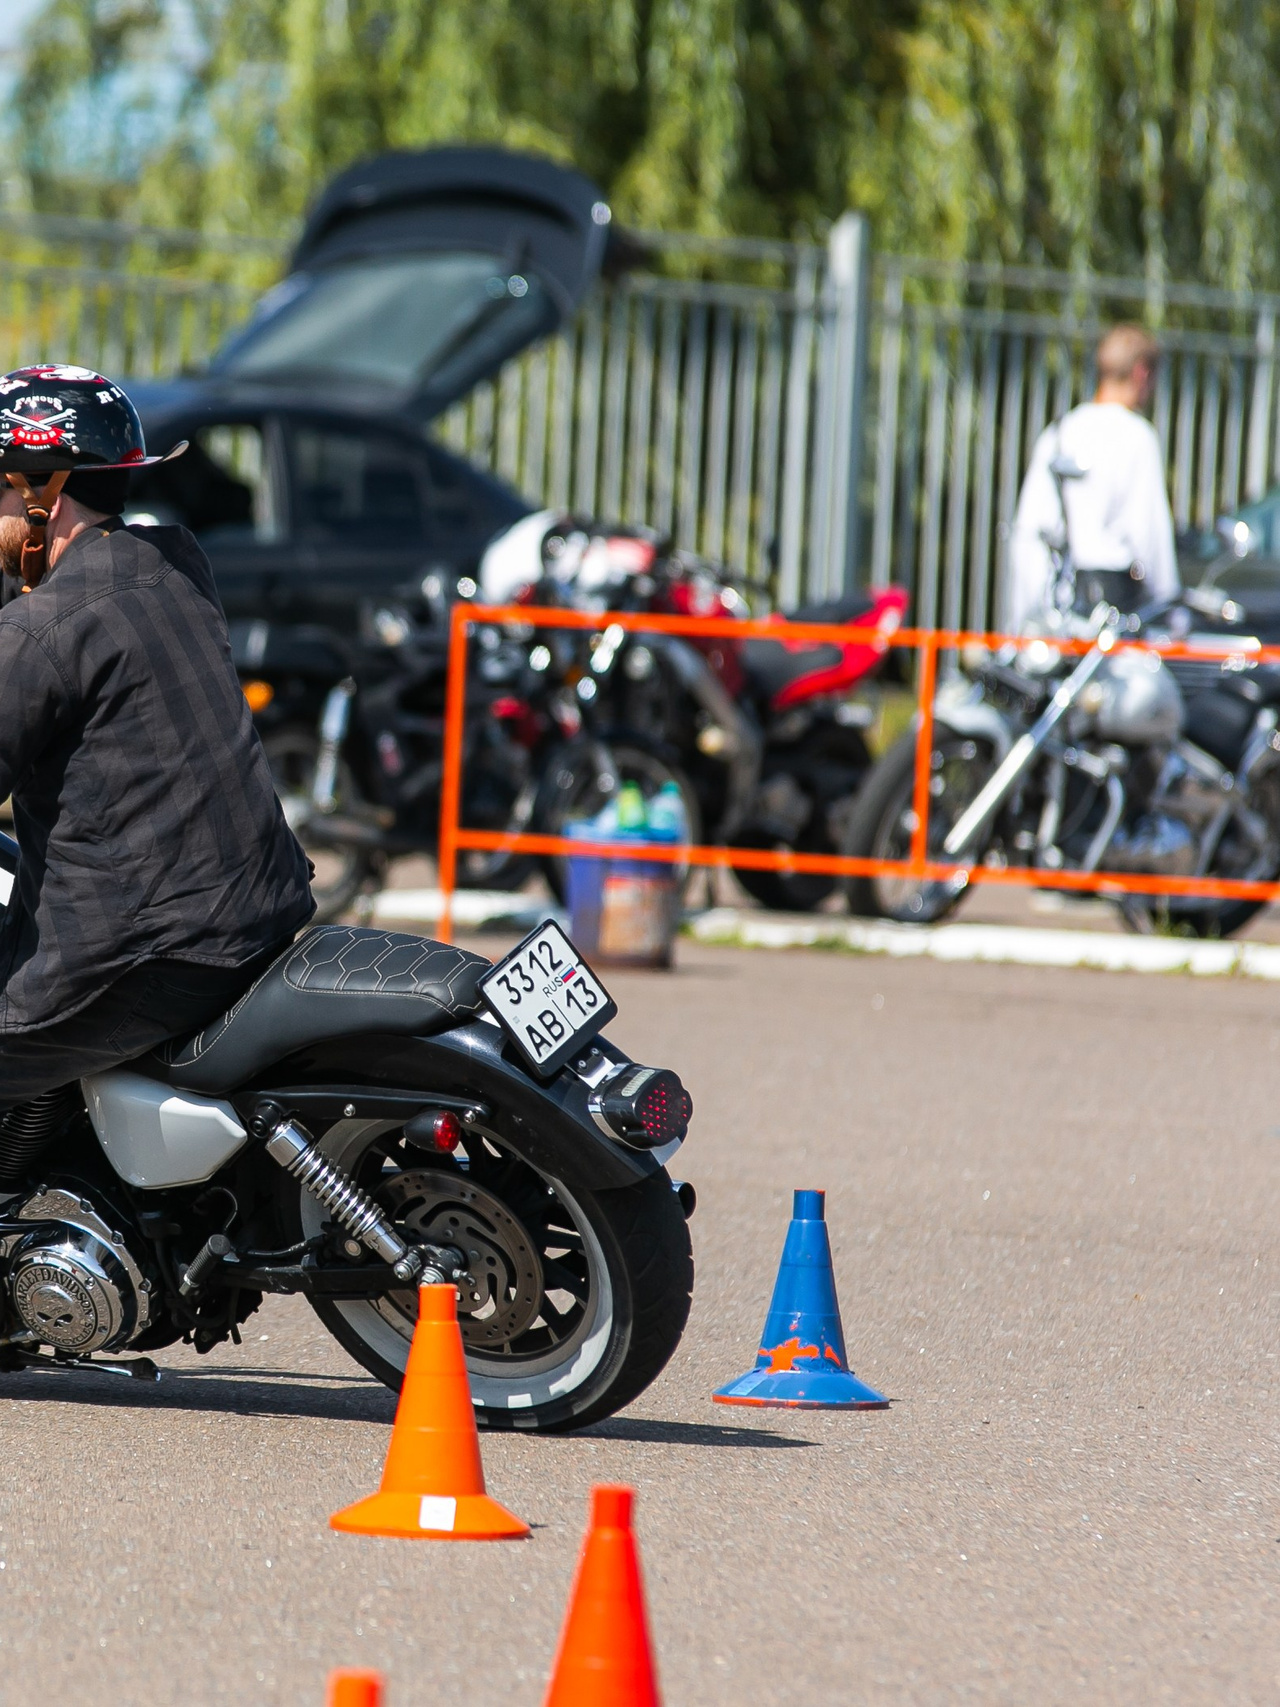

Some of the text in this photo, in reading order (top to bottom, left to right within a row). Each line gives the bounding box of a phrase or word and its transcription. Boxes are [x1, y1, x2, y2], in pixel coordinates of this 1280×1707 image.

[13, 395, 63, 413] FAMOUS
[17, 430, 57, 441] RIDER
[496, 940, 563, 1005] 3312
[542, 977, 563, 998] RUS
[525, 976, 598, 1058] AB 13
[29, 1322, 94, 1345] MOTORCYCLES
